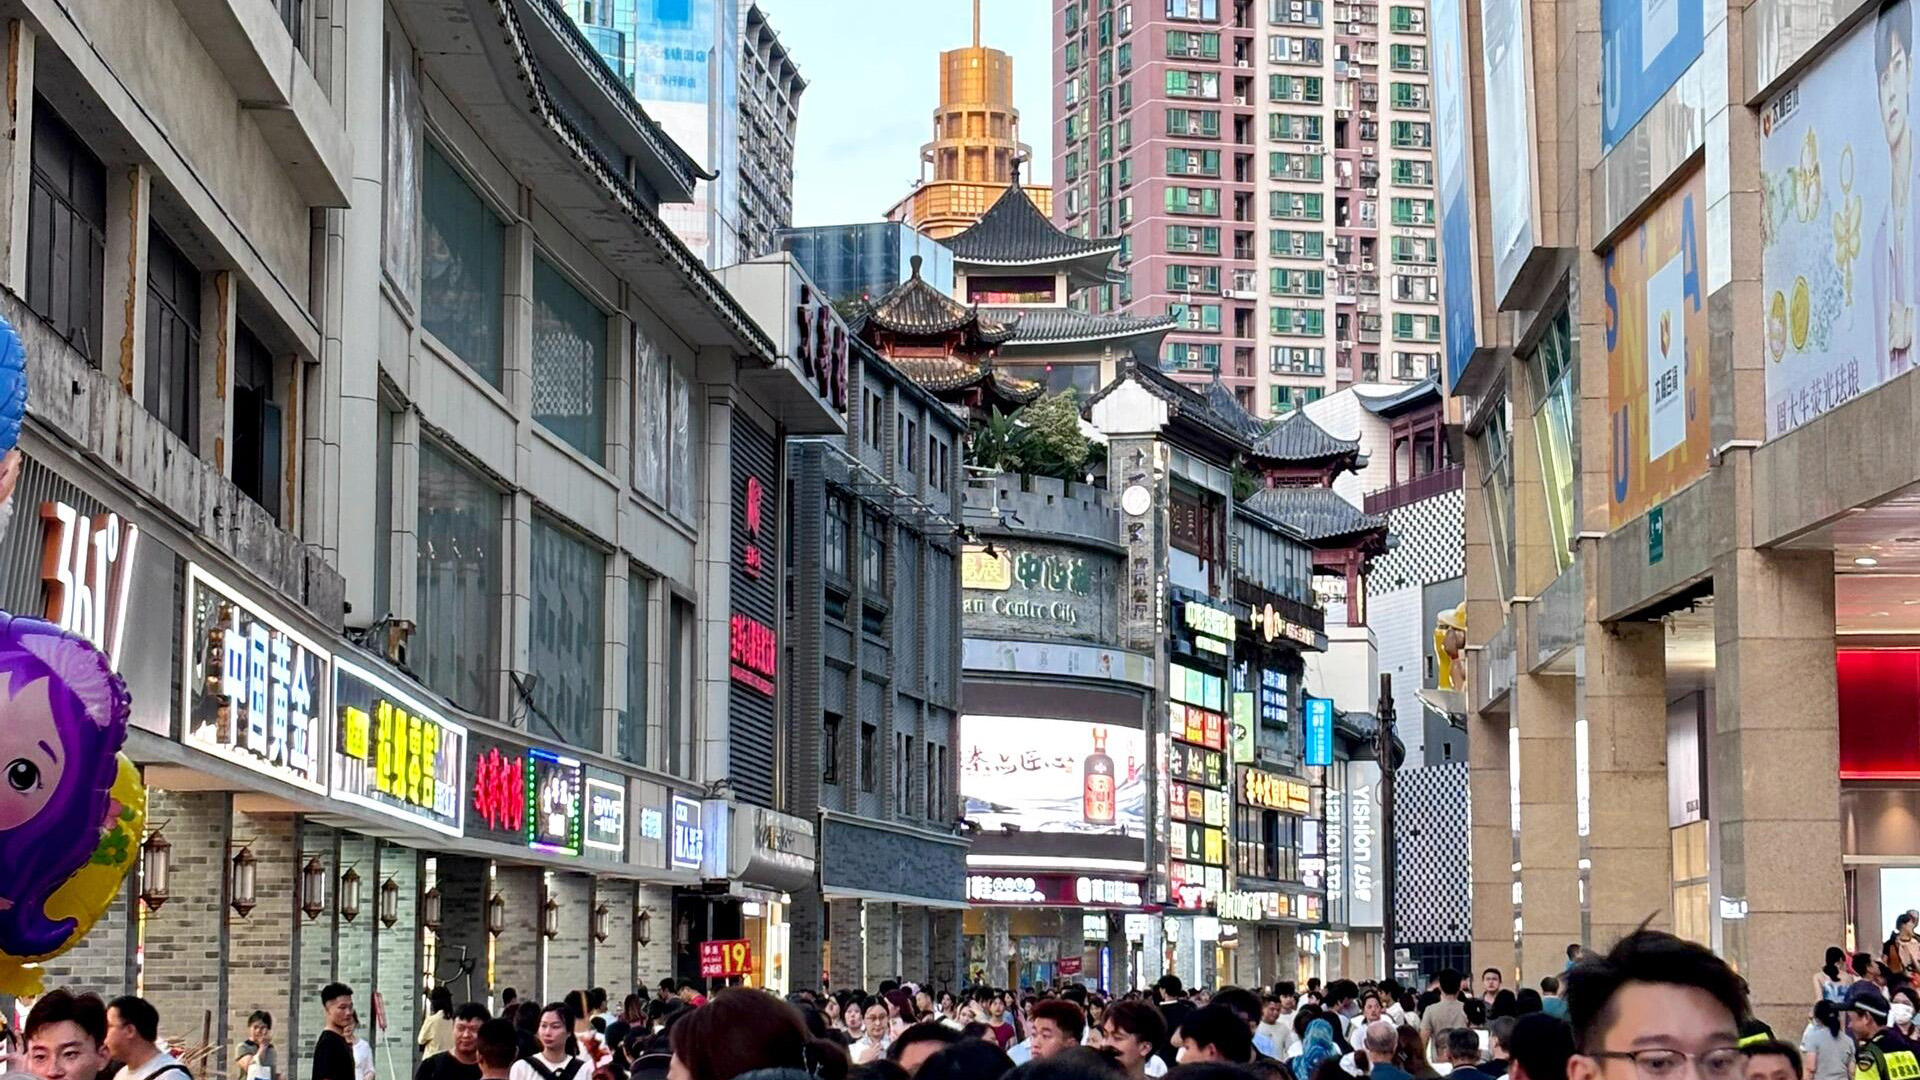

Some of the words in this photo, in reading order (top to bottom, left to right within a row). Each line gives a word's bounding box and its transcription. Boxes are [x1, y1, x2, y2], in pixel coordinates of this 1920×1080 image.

[992, 595, 1048, 619] Centre
[1051, 602, 1077, 626] City
[223, 604, 312, 773] 中国黄金
[722, 943, 746, 972] 19
